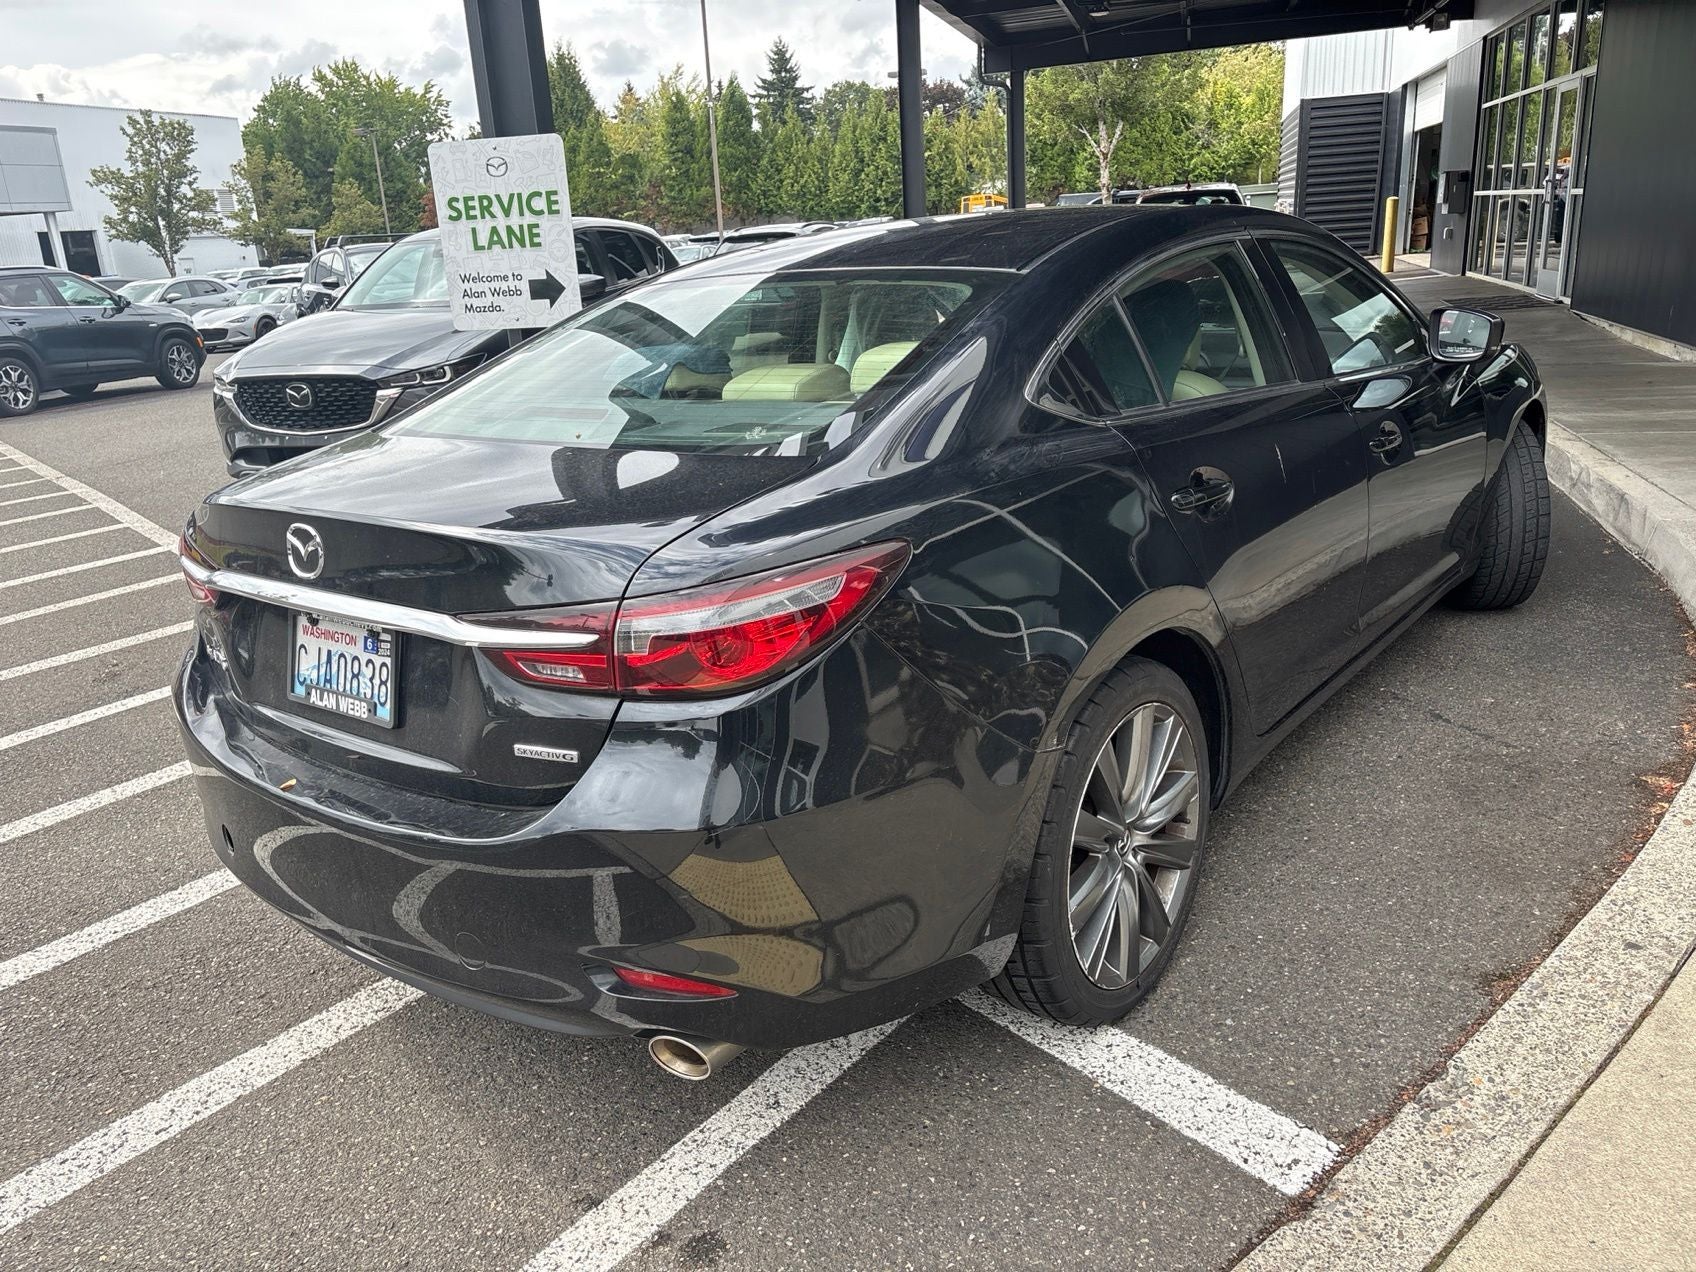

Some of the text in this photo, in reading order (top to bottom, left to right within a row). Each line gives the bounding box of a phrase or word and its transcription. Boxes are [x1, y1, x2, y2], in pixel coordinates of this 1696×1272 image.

[447, 190, 561, 221] SERVICE
[471, 223, 542, 251] LANE
[459, 272, 523, 284] Welcome to
[462, 285, 523, 299] Alan Webb
[464, 302, 505, 313] Mazda.
[301, 624, 357, 647] WASHINGTON
[297, 643, 390, 707] CJA0838
[310, 688, 368, 719] ALAN WEBB
